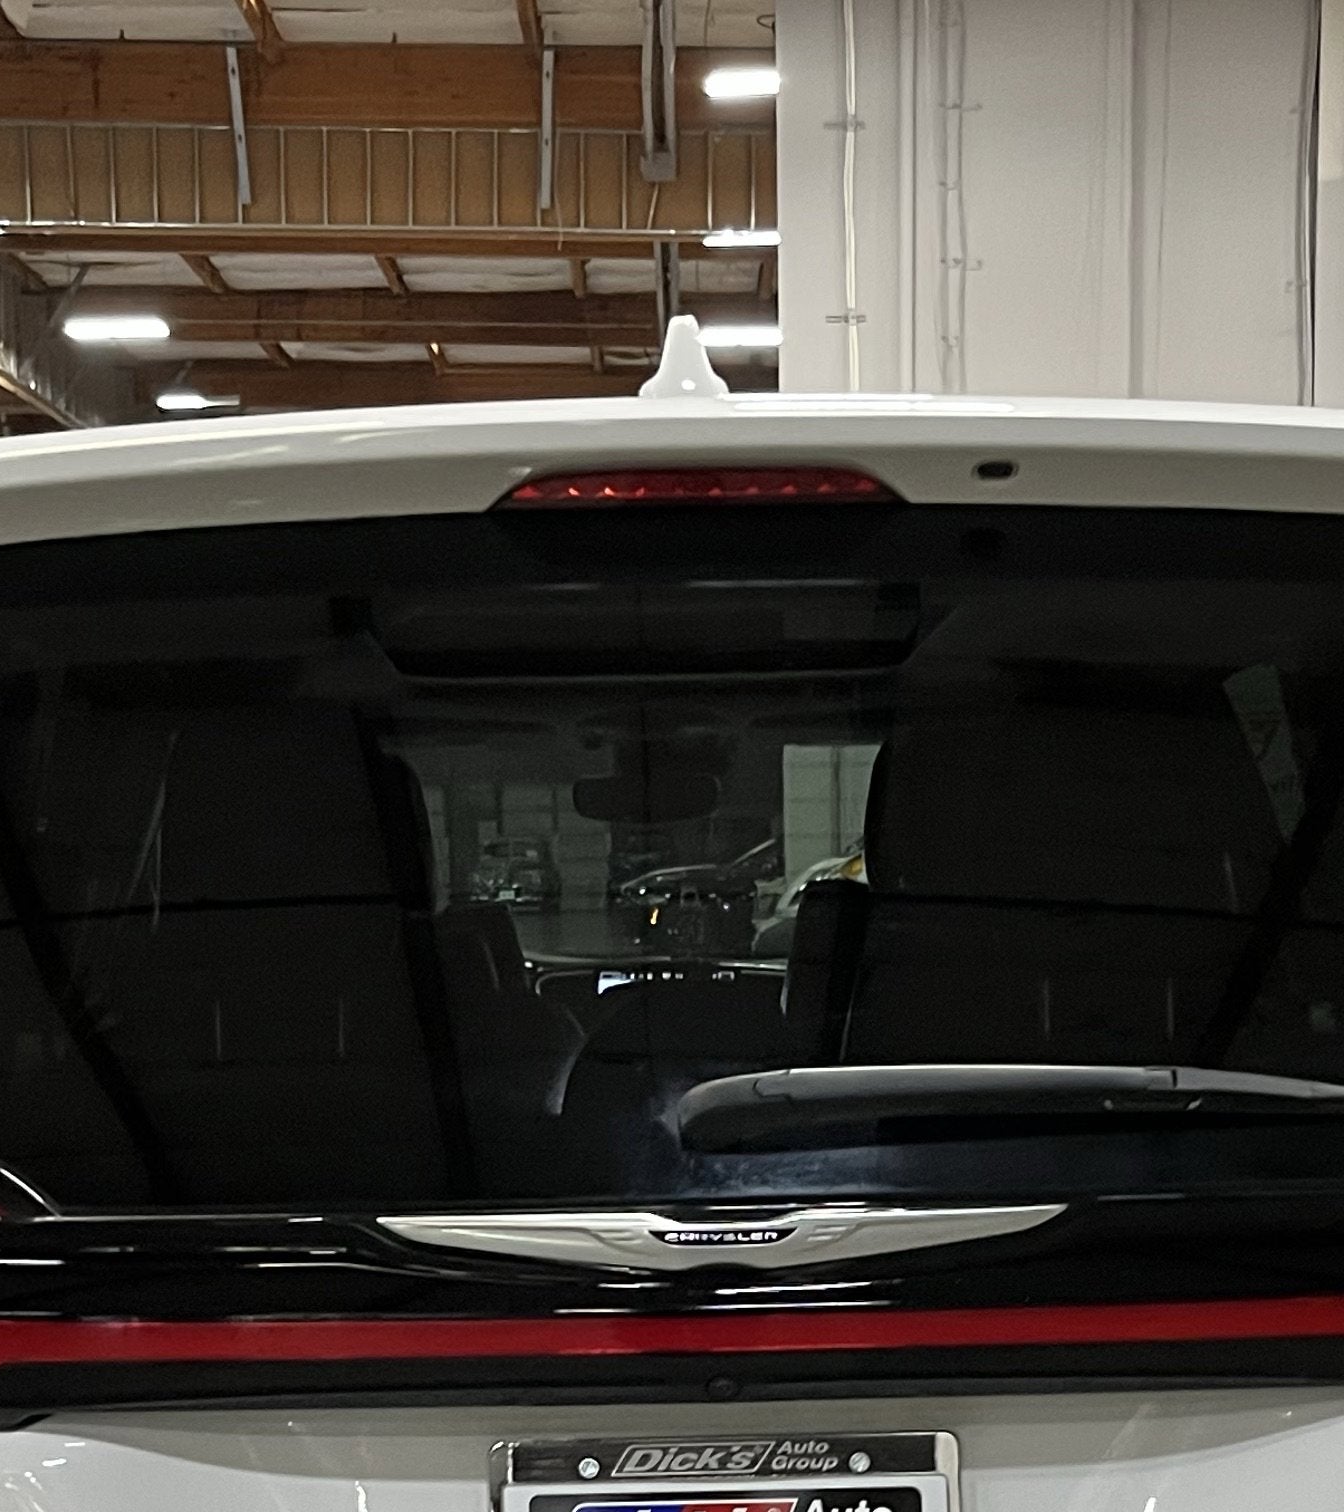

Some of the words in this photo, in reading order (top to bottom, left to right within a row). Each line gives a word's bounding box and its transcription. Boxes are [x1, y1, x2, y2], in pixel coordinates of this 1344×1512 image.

[622, 1445, 756, 1473] Dick's
[775, 1440, 830, 1455] Auto
[771, 1454, 839, 1472] Group
